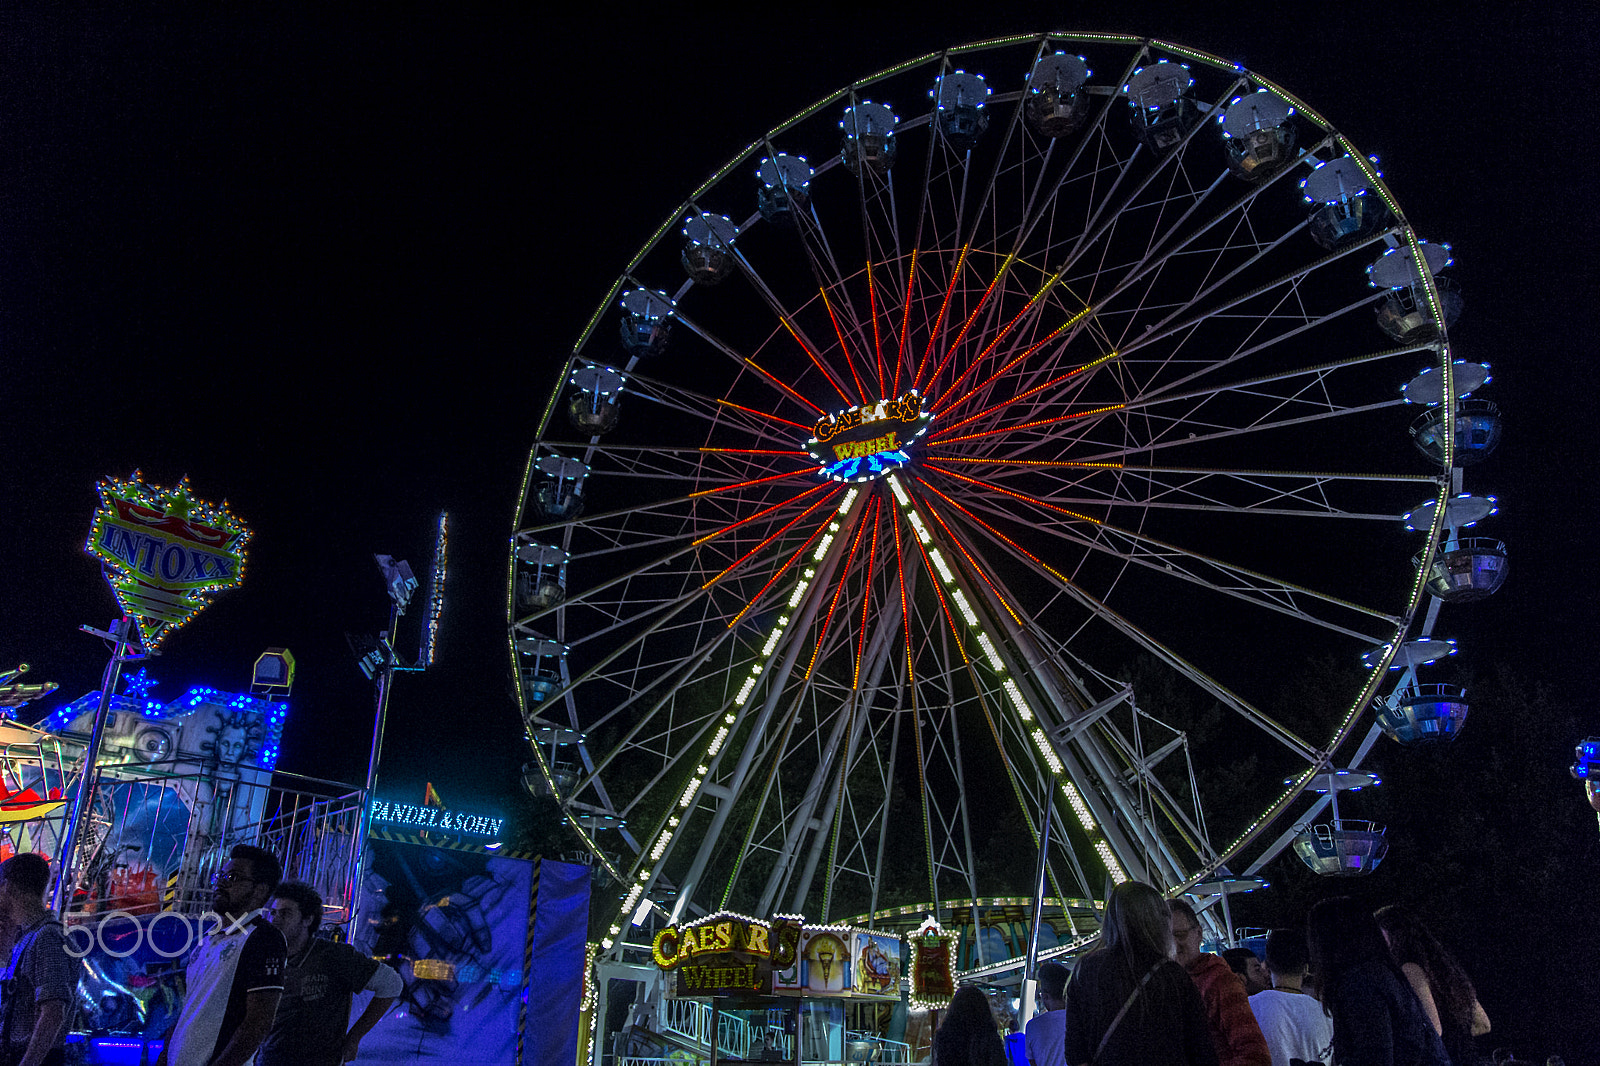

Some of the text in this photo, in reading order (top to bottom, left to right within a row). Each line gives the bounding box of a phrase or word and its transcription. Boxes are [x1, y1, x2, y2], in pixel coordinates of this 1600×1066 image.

[832, 431, 900, 461] WHEEL
[99, 521, 238, 584] INTOXX
[370, 800, 503, 837] PANDEL & SOHN
[681, 964, 764, 989] WHEEL
